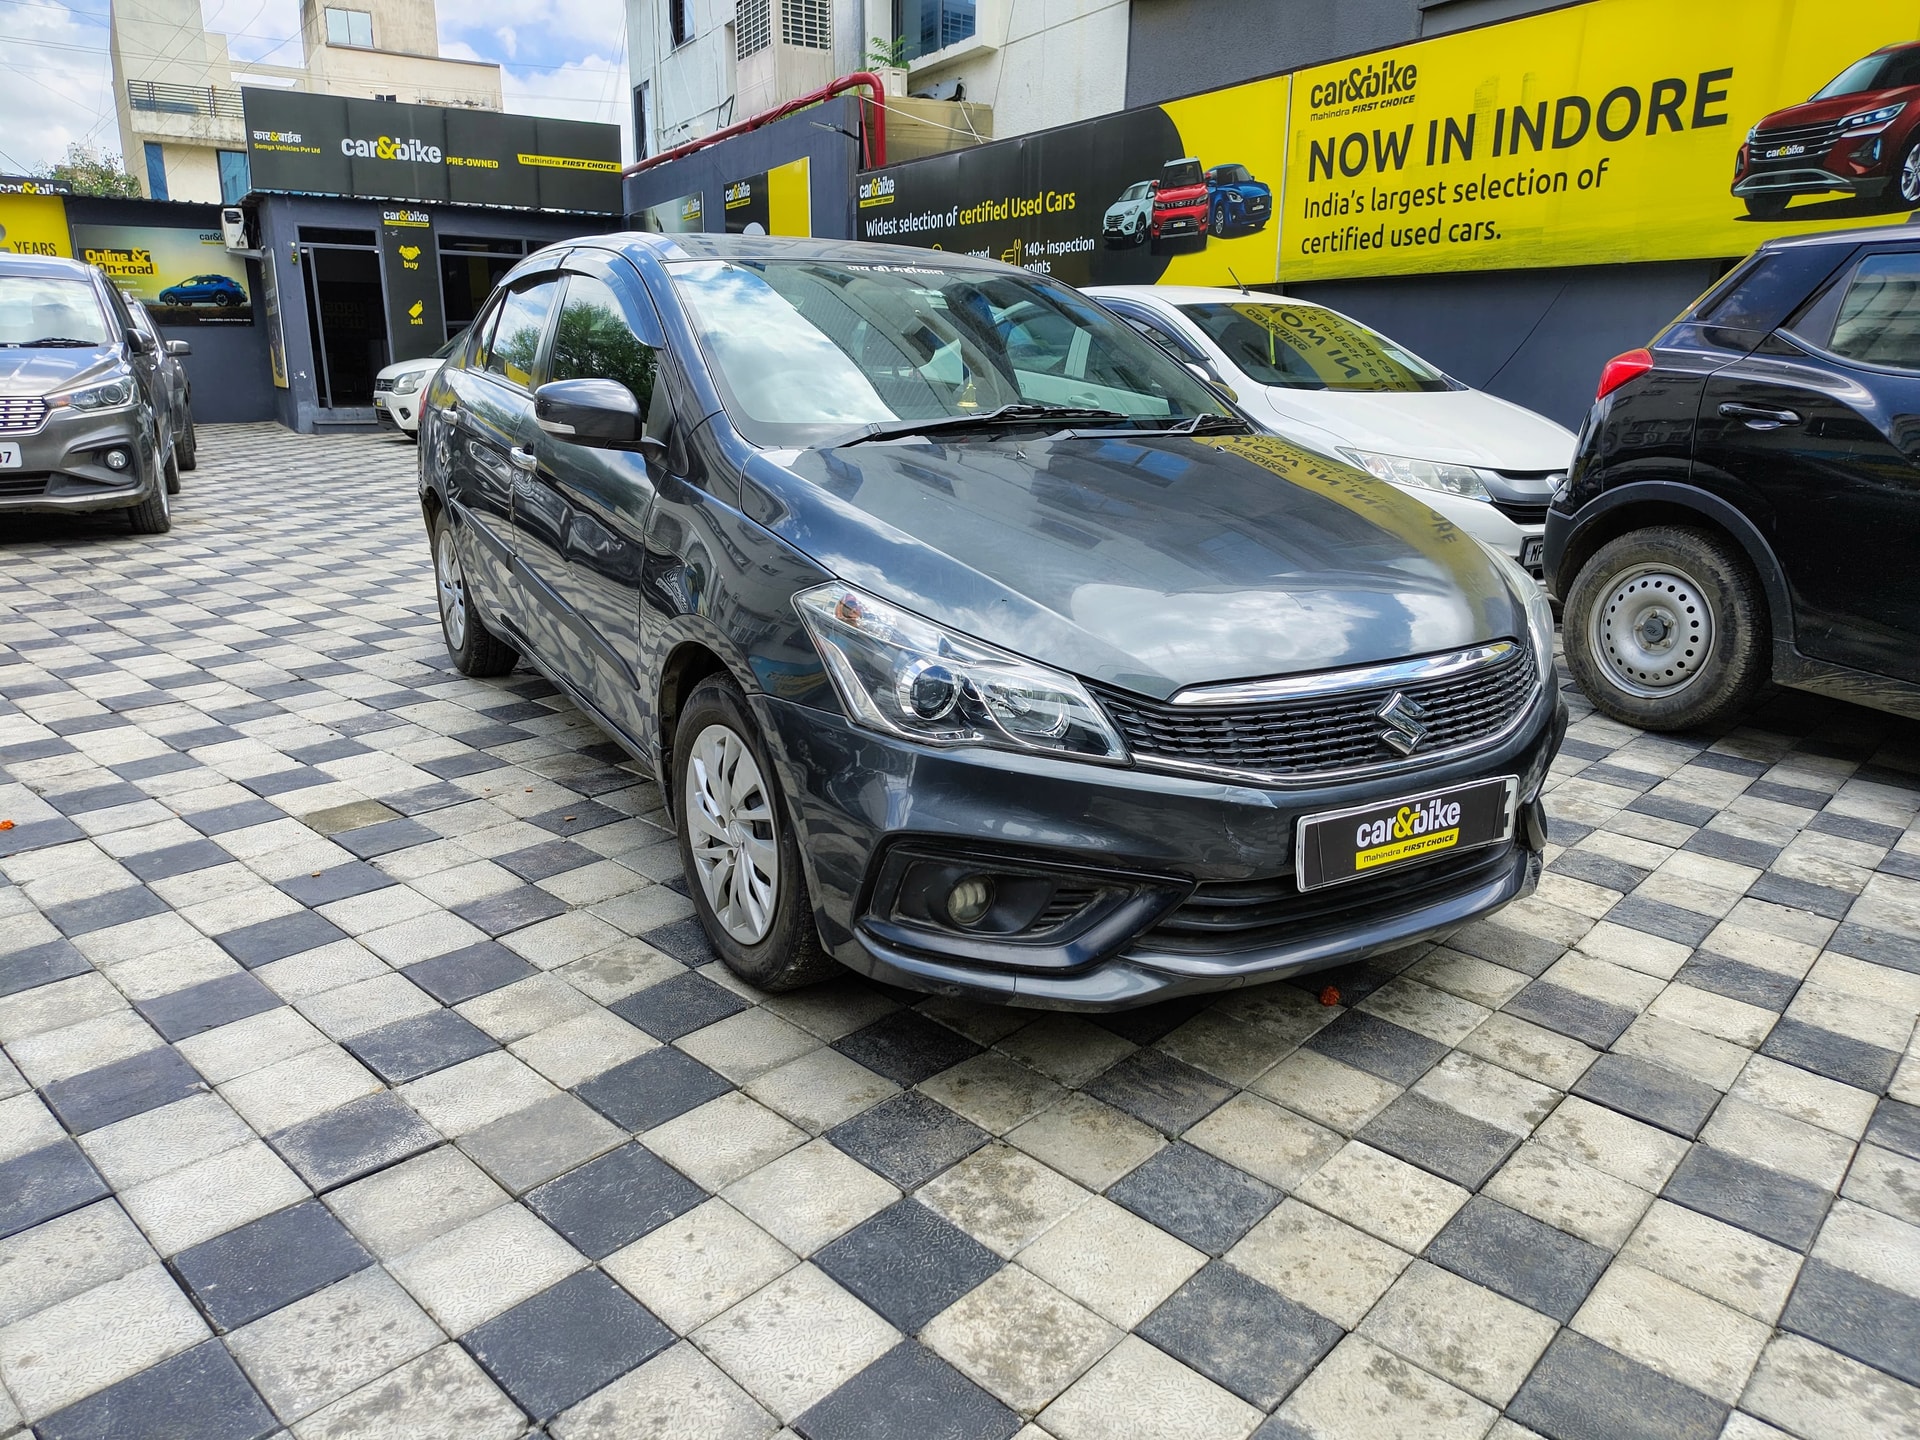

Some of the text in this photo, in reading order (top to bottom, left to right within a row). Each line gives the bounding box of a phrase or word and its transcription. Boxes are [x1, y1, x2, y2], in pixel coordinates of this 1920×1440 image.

[1310, 60, 1417, 109] car&bike
[1310, 95, 1415, 122] Mahindra FIRST CHOICE
[1309, 67, 1734, 182] NOW IN INDORE
[341, 136, 442, 164] car&bike
[446, 156, 499, 169] PRE-OWNED
[521, 156, 561, 165] Mahindra
[561, 160, 585, 168] FIRST
[859, 175, 895, 199] car&bike
[1371, 181, 1447, 214] largest
[1453, 168, 1568, 202] selection
[1577, 157, 1609, 190] of
[383, 210, 429, 222] car&bike
[866, 190, 1076, 237] Widest selection of certified Used Cars
[13, 241, 57, 256] YEARS
[1024, 236, 1095, 257] 140+ inspection
[1301, 218, 1502, 255] certified used cars.
[85, 249, 129, 262] Online
[403, 260, 419, 270] buy
[1356, 798, 1461, 848] car&bike
[1363, 834, 1455, 863] Mahindra FIRST CHOICE
